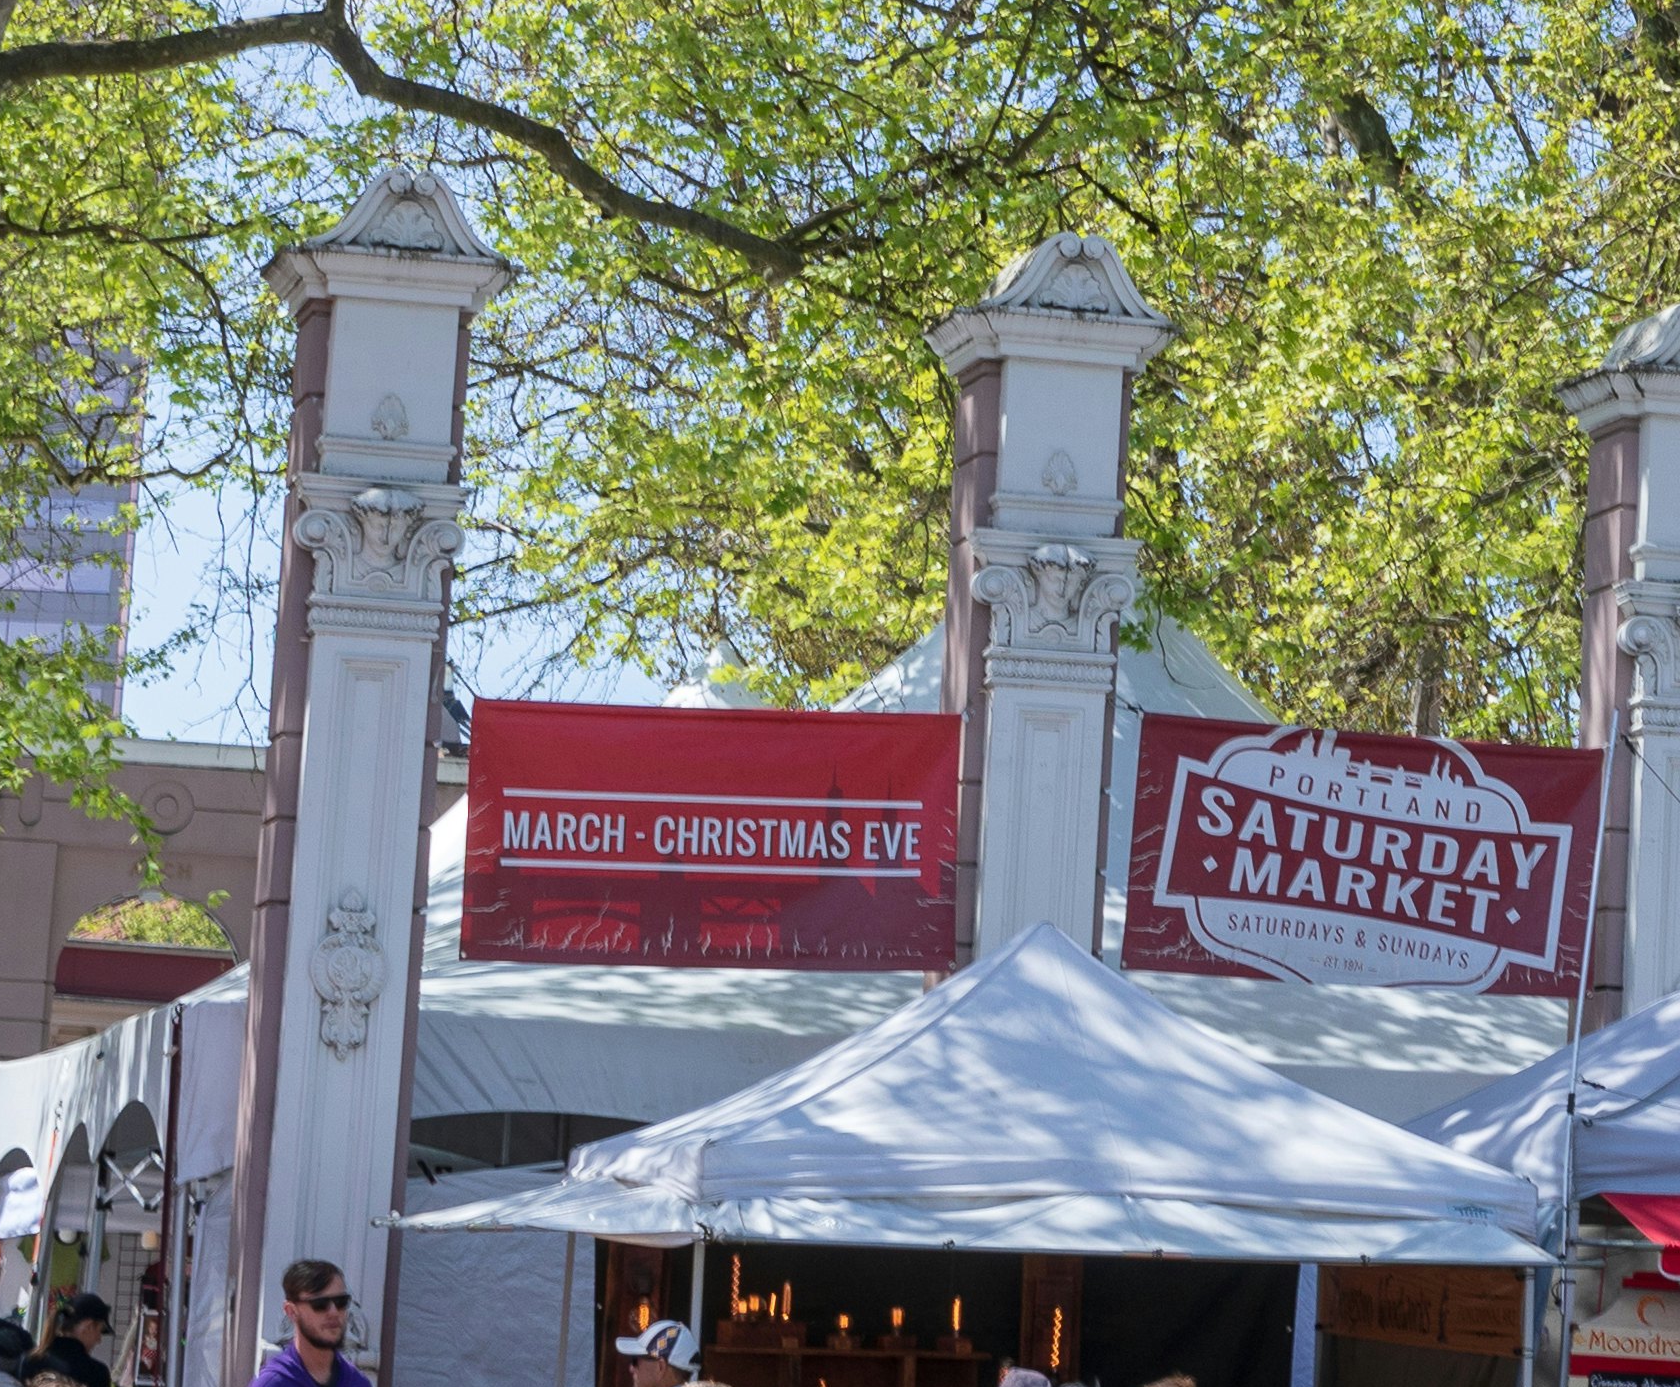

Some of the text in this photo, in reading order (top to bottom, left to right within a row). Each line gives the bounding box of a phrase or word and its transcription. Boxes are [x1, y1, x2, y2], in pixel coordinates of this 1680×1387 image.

[1268, 763, 1484, 825] PORTLAND
[502, 810, 625, 854] MARCH
[654, 814, 851, 861] CHRISTMAS
[862, 820, 922, 862] EVE
[1196, 785, 1548, 891] SATURDAY
[1229, 852, 1502, 935] MARKET
[1227, 913, 1470, 970] SATURDAYS & SUNDAYS
